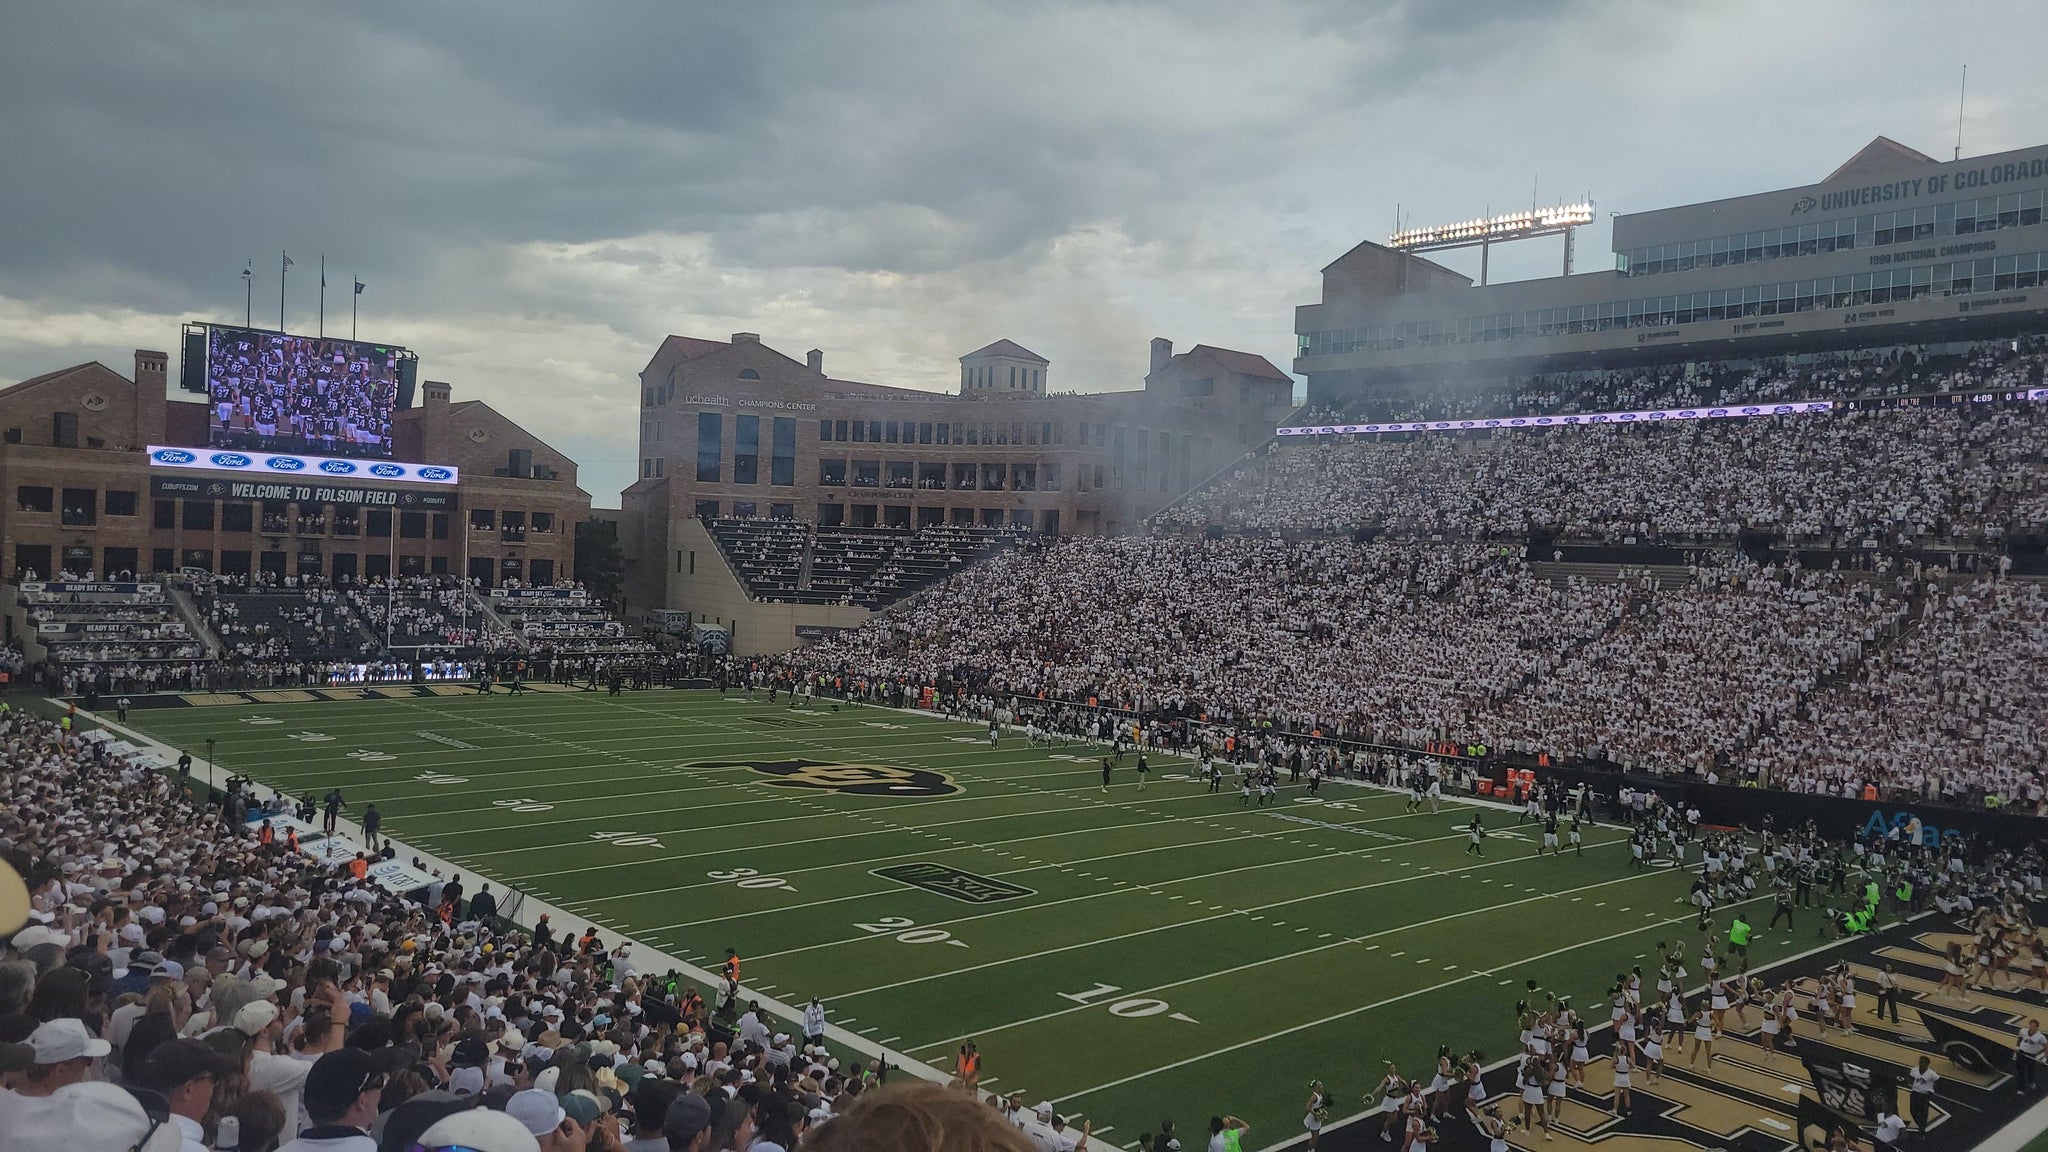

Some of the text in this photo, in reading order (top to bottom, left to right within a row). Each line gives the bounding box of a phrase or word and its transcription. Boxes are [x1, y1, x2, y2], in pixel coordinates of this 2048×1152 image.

[1821, 178, 1923, 211] UNIVERSITY
[1927, 174, 1949, 194] OF
[1893, 246, 1938, 263] NATIONAL
[1940, 240, 1997, 257] CHAMPIONS
[685, 393, 816, 411] uchealth CHAMPIONS CENTER
[1972, 394, 1993, 403] 4:09
[261, 410, 275, 419] 52
[160, 451, 446, 480] Ford Ford Ford Ford Ford Ford
[161, 483, 199, 491] CUBUFFS.COM
[232, 482, 397, 505] WELCOME TO FOLSOM FIELD
[65, 584, 86, 592] READY
[86, 624, 108, 632] READY
[492, 797, 555, 812] 50
[589, 830, 659, 846] 40
[386, 872, 421, 888] AT&T
[707, 867, 788, 889] 30
[852, 916, 951, 944] 20
[1056, 982, 1170, 1018] 10
